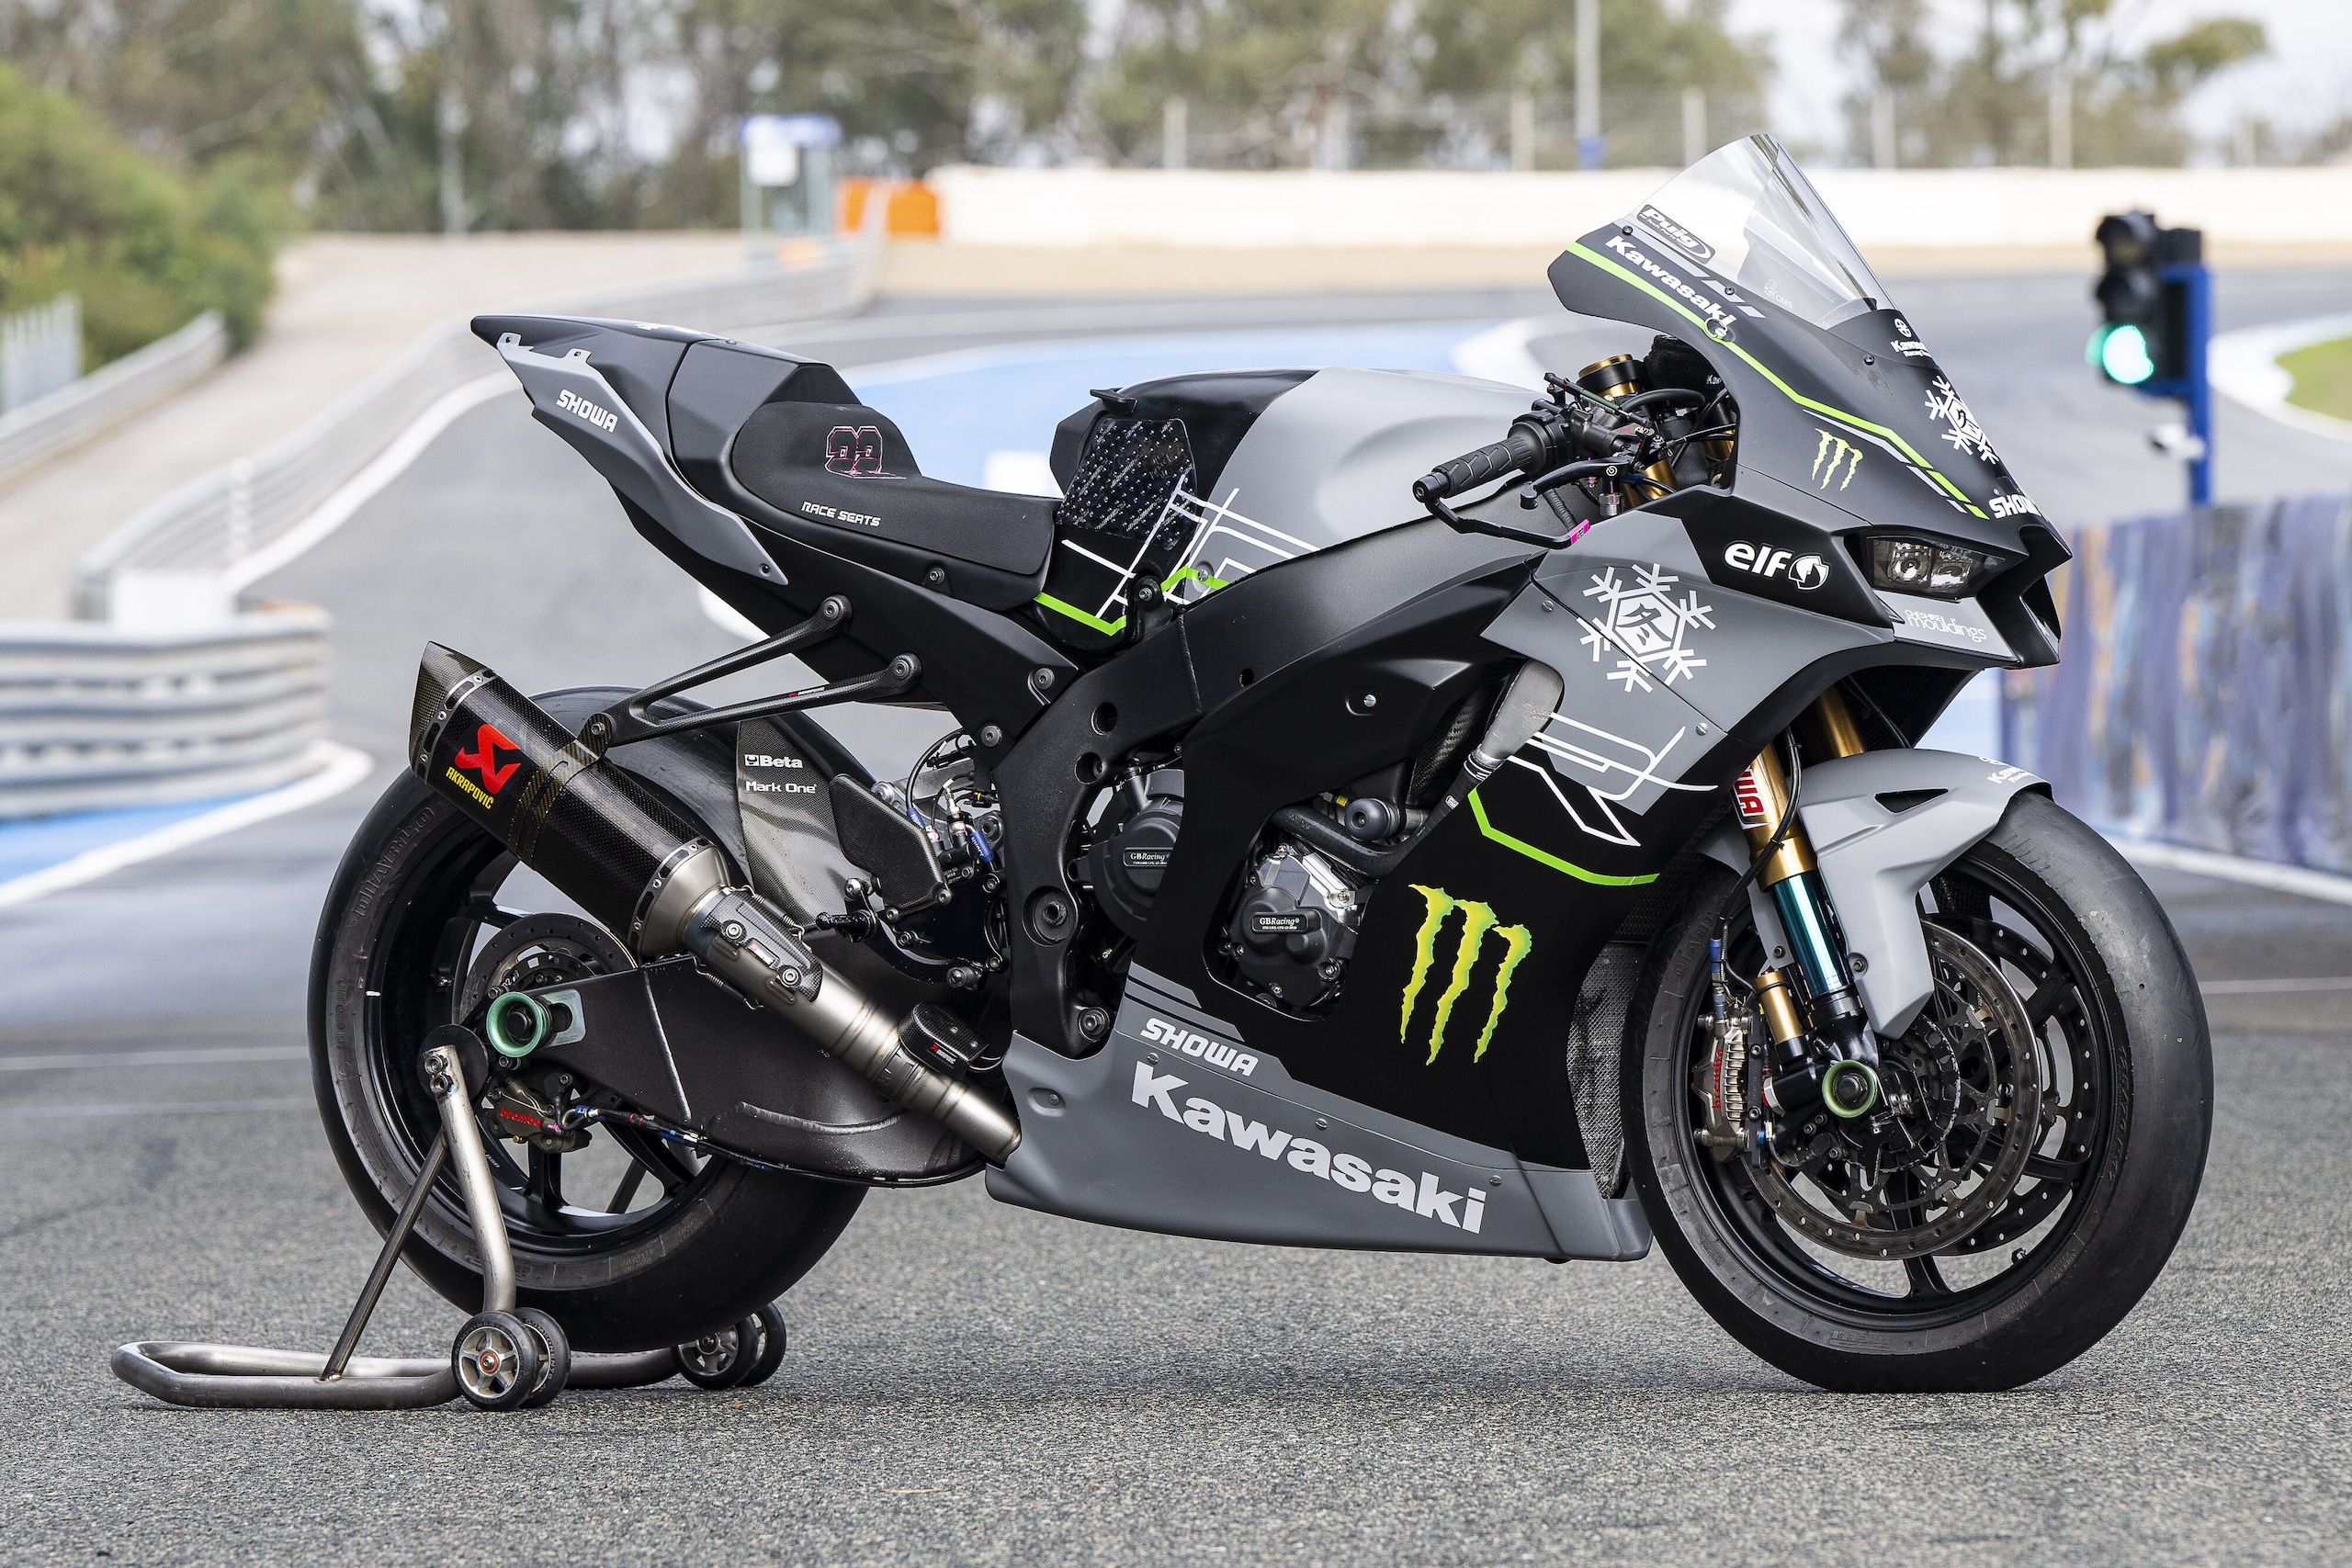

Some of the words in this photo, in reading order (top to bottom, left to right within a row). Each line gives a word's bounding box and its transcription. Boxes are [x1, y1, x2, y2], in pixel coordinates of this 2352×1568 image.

[1643, 208, 1700, 248] Puig
[1604, 235, 1737, 327] Kawasaki
[555, 389, 618, 434] SHOWA
[801, 501, 837, 519] RACE
[837, 511, 882, 527] SEATS
[1988, 494, 2042, 519] SHOW
[1724, 542, 1792, 578] elf
[1905, 609, 1942, 622] CHESHIRE
[1906, 616, 1987, 643] mouldings
[759, 754, 804, 769] Beta
[745, 781, 782, 792] Mark
[1140, 1017, 1259, 1077] SHOWA
[1712, 1048, 1724, 1110] brembo
[500, 1106, 542, 1127] brembo
[1131, 1060, 1487, 1234] Kawasaki
